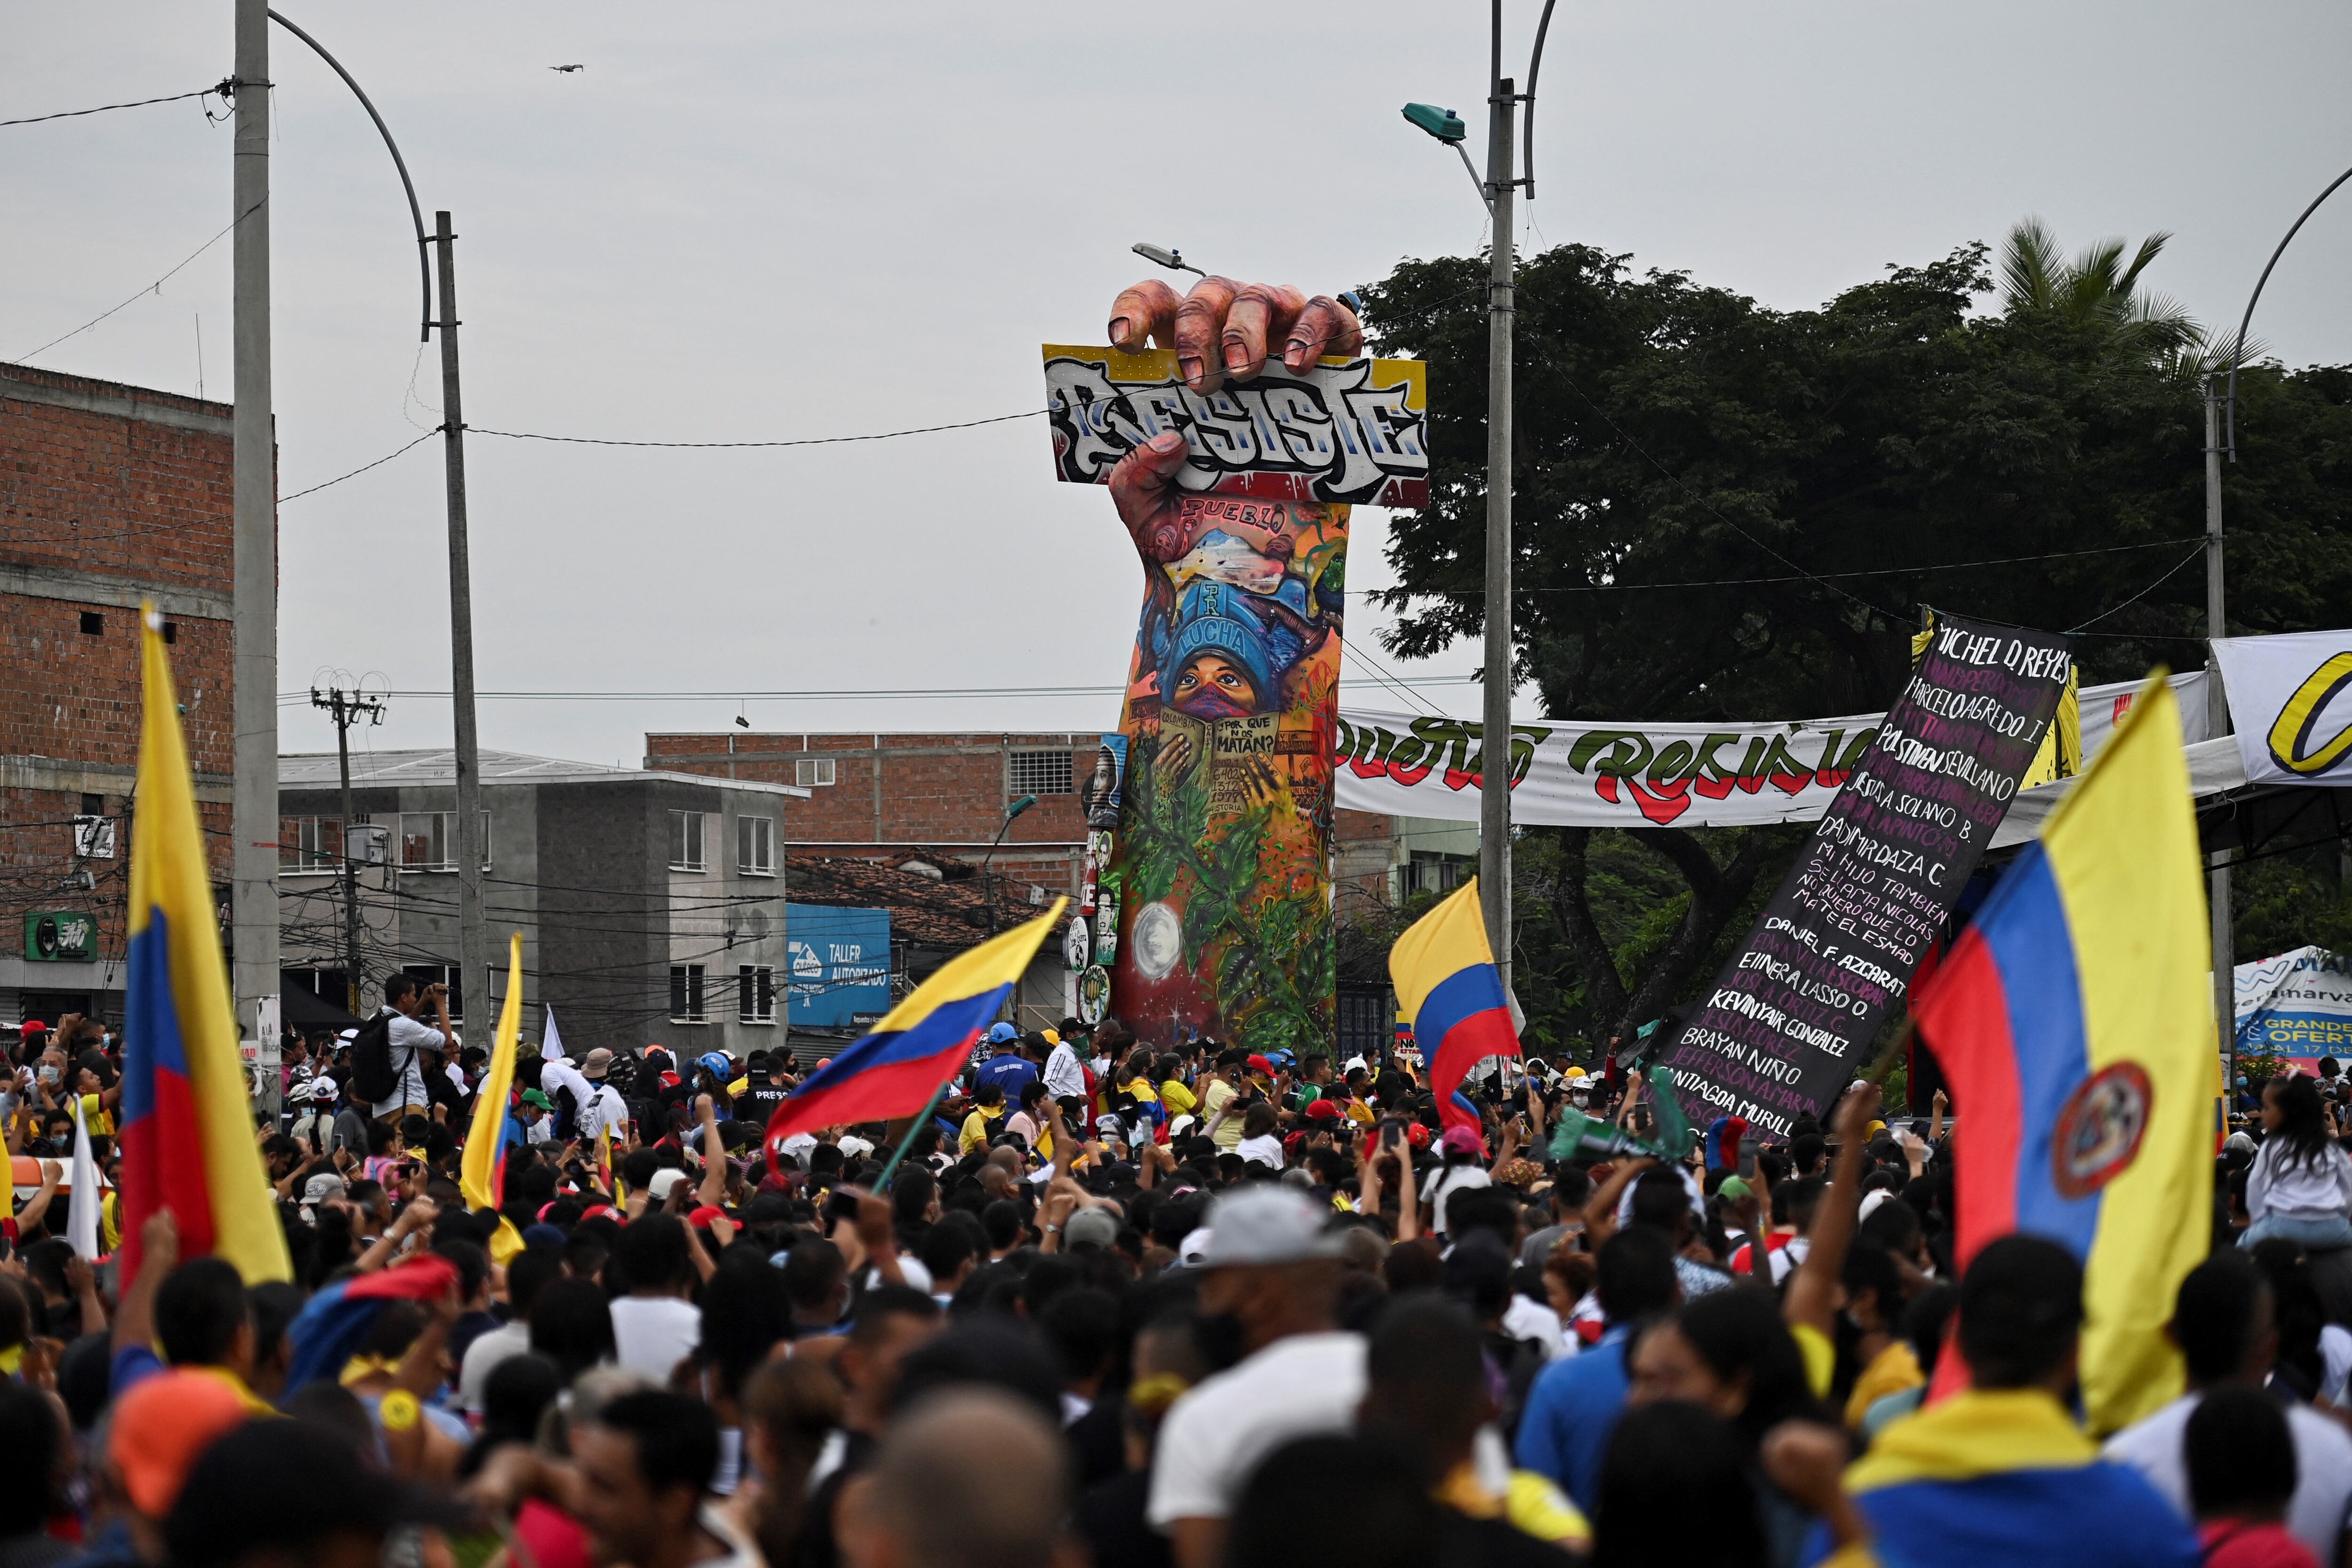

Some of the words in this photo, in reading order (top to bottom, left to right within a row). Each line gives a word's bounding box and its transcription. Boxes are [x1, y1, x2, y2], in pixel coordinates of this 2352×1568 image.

[1182, 499, 1286, 534] PUEBLO
[1179, 622, 1246, 659] LUCHA
[1939, 623, 2001, 665] MICHEL
[2018, 646, 2072, 684] REYES
[1162, 712, 1196, 730] COLOMBIA
[1248, 717, 1271, 728] QUE
[1904, 675, 1965, 719] MARCELO
[1960, 696, 2025, 737] AGREDO
[1217, 735, 1274, 753] MATAN?
[1213, 767, 1239, 780] 6402
[1213, 780, 1240, 792] 1312
[1939, 750, 2015, 801] SEVILLANO
[1210, 804, 1242, 813] HISTORIA
[1211, 792, 1241, 804] 1977
[1846, 772, 1885, 803] JESUS
[1880, 790, 1894, 810] A.
[1896, 795, 1956, 828] SOLANO
[1959, 820, 1971, 844] B.
[1816, 816, 1878, 861] DADIMIR
[1874, 844, 1924, 877] DAZA
[1928, 863, 1946, 888] C.
[1807, 859, 1830, 882] SE
[1830, 870, 1880, 909] LLAMA
[1816, 842, 1836, 862] MI
[1839, 853, 1875, 884] HIJO
[1882, 877, 1948, 925] TAMBIÉN
[1792, 889, 1839, 924] MATE
[1838, 917, 1857, 937] EL
[1797, 874, 1818, 890] NO
[1818, 884, 1862, 915] QUIERO
[1861, 912, 1894, 932] QUE
[1894, 927, 1917, 947] LO
[829, 944, 860, 963] TALLER
[1764, 917, 1819, 954] DANIEL
[1822, 946, 1839, 961] F.
[796, 961, 818, 973] auteco
[832, 967, 886, 987] AUTORIZADO
[803, 995, 810, 1007] JK
[1785, 971, 1801, 990] A
[1799, 979, 1850, 1009] LASSO
[1852, 1001, 1868, 1020] O.
[1825, 965, 1889, 1010] ESCOBAR
[853, 1016, 869, 1025] Repuestos
[1707, 989, 1760, 1019] KEVIN
[1756, 1003, 1787, 1033] YAIR
[1785, 1019, 1850, 1058] GONZALEZ
[1778, 990, 1829, 1026] ORTIZ
[2265, 1019, 2352, 1032] GRANDE
[1663, 1047, 1757, 1091] JEFFERSON
[1680, 1027, 1747, 1060] BRAYAN
[1747, 1049, 1803, 1085] NIÑO
[1649, 1066, 1727, 1106] NTIAGO
